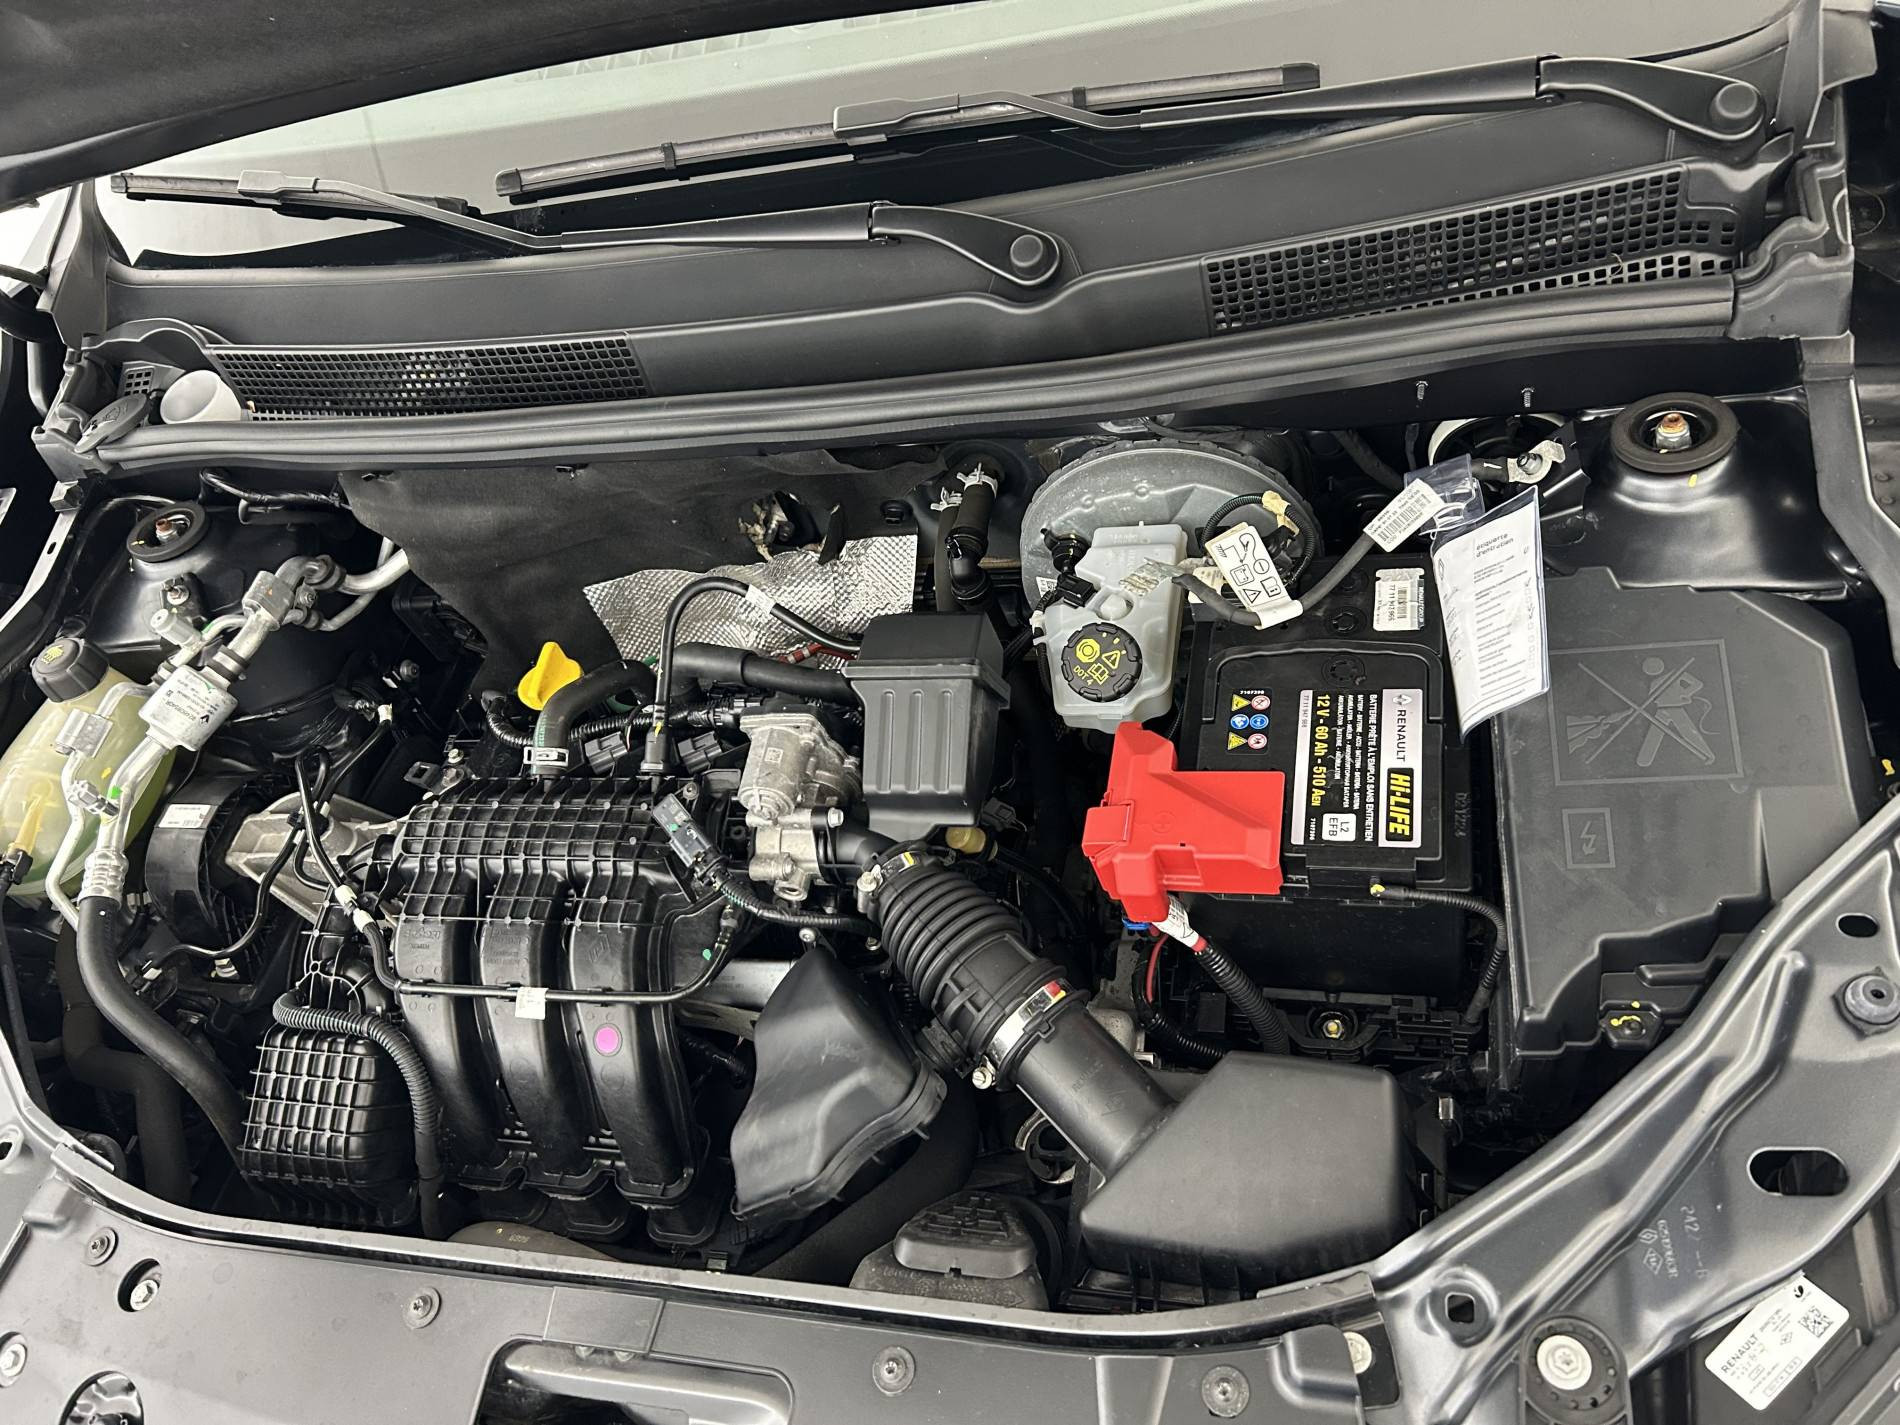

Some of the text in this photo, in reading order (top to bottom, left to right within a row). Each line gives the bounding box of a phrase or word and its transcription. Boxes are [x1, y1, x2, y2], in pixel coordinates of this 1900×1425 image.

[1073, 665, 1089, 680] DOT
[1317, 694, 1331, 707] 12
[1368, 694, 1378, 724] BATTERIE
[1316, 709, 1330, 717] V
[1315, 725, 1329, 740] 60
[1368, 724, 1378, 746] PRÊTE
[1396, 709, 1407, 762] RENAULT
[1314, 741, 1328, 756] Ah
[1312, 766, 1327, 787] 510
[1367, 752, 1376, 784] L'EMPLOI
[1365, 784, 1375, 803] SANS
[1328, 817, 1338, 837] EFB
[1340, 821, 1350, 833] L2
[1364, 803, 1374, 842] ENTRETIEN
[1720, 1333, 1759, 1374] RENAULT
